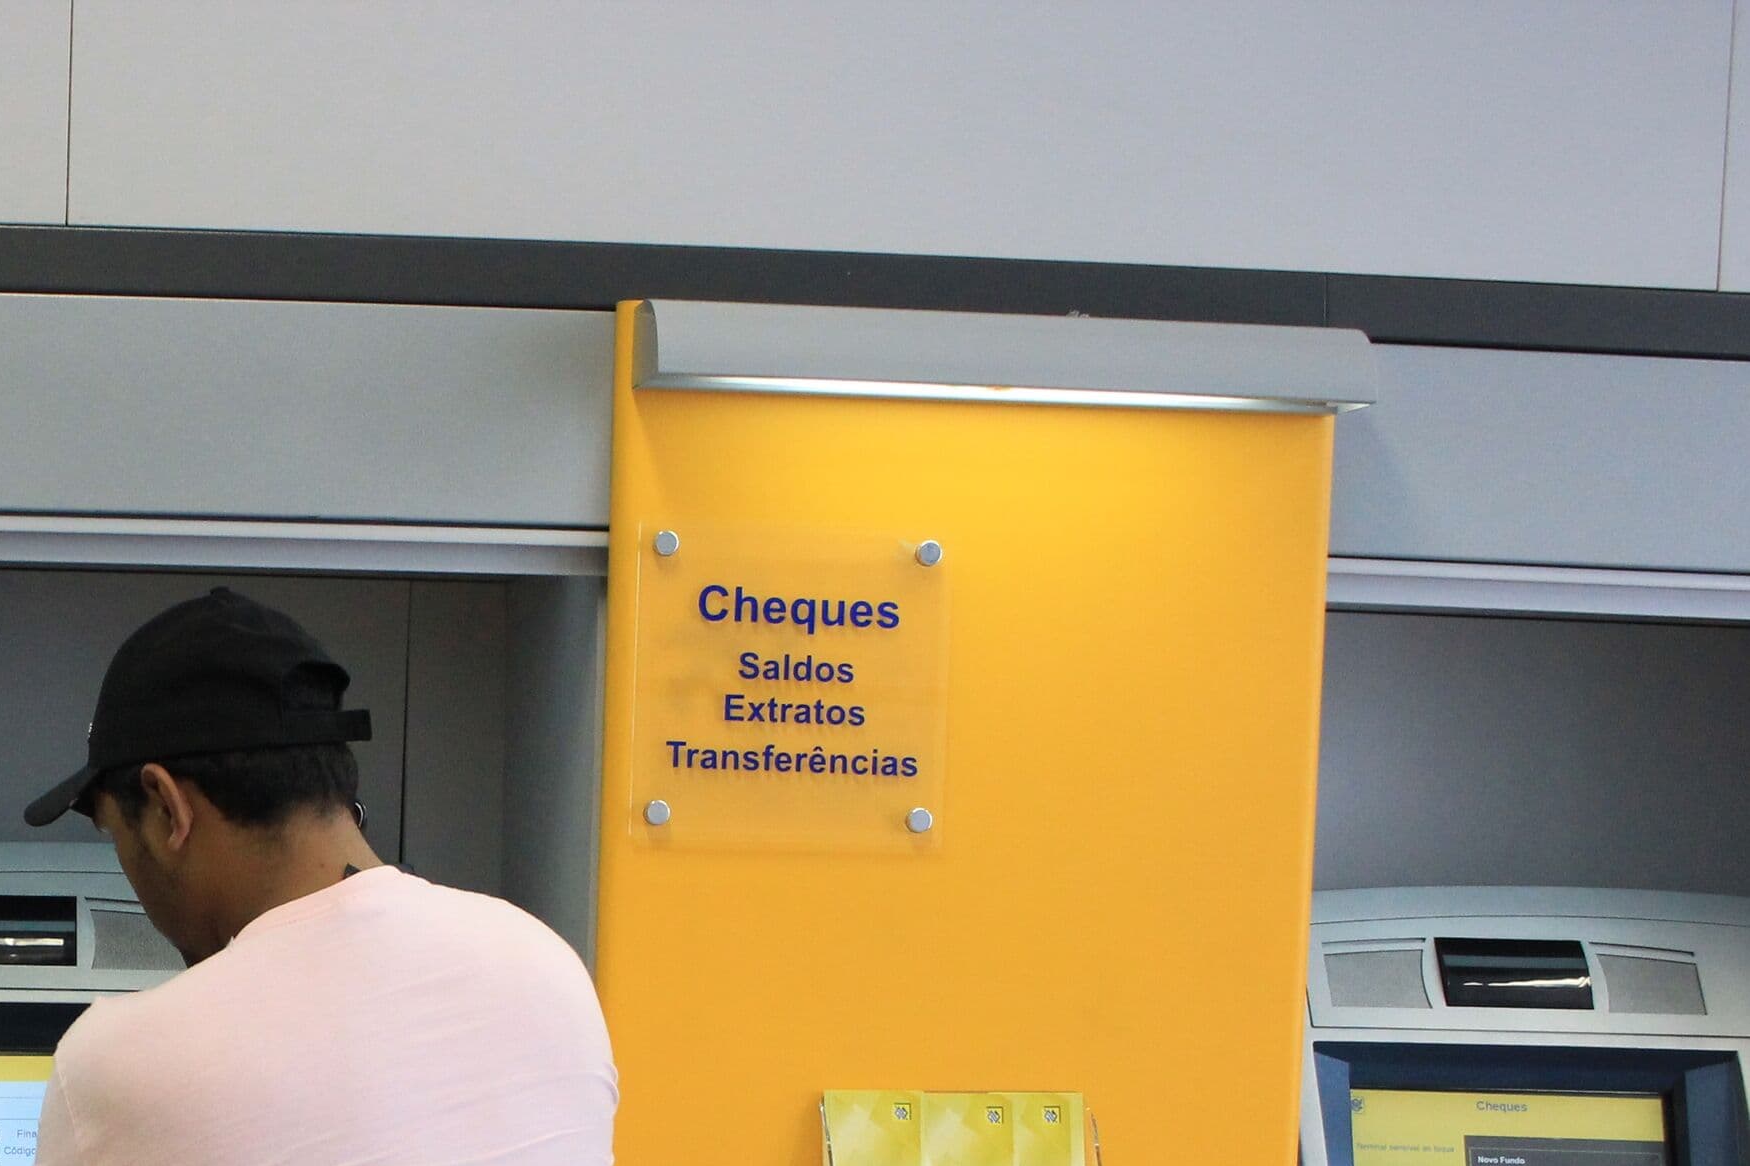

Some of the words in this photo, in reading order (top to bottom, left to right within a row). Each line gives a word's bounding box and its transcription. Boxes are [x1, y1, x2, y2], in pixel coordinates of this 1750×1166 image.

[698, 584, 900, 635] Cheques
[738, 651, 855, 684] Saldos
[723, 693, 866, 727] Extratos
[666, 740, 919, 778] Transferências
[1475, 1100, 1528, 1114] Cheques
[16, 1129, 37, 1138] Fina
[1477, 1156, 1499, 1164] Novo
[1499, 1156, 1526, 1164] Fundo
